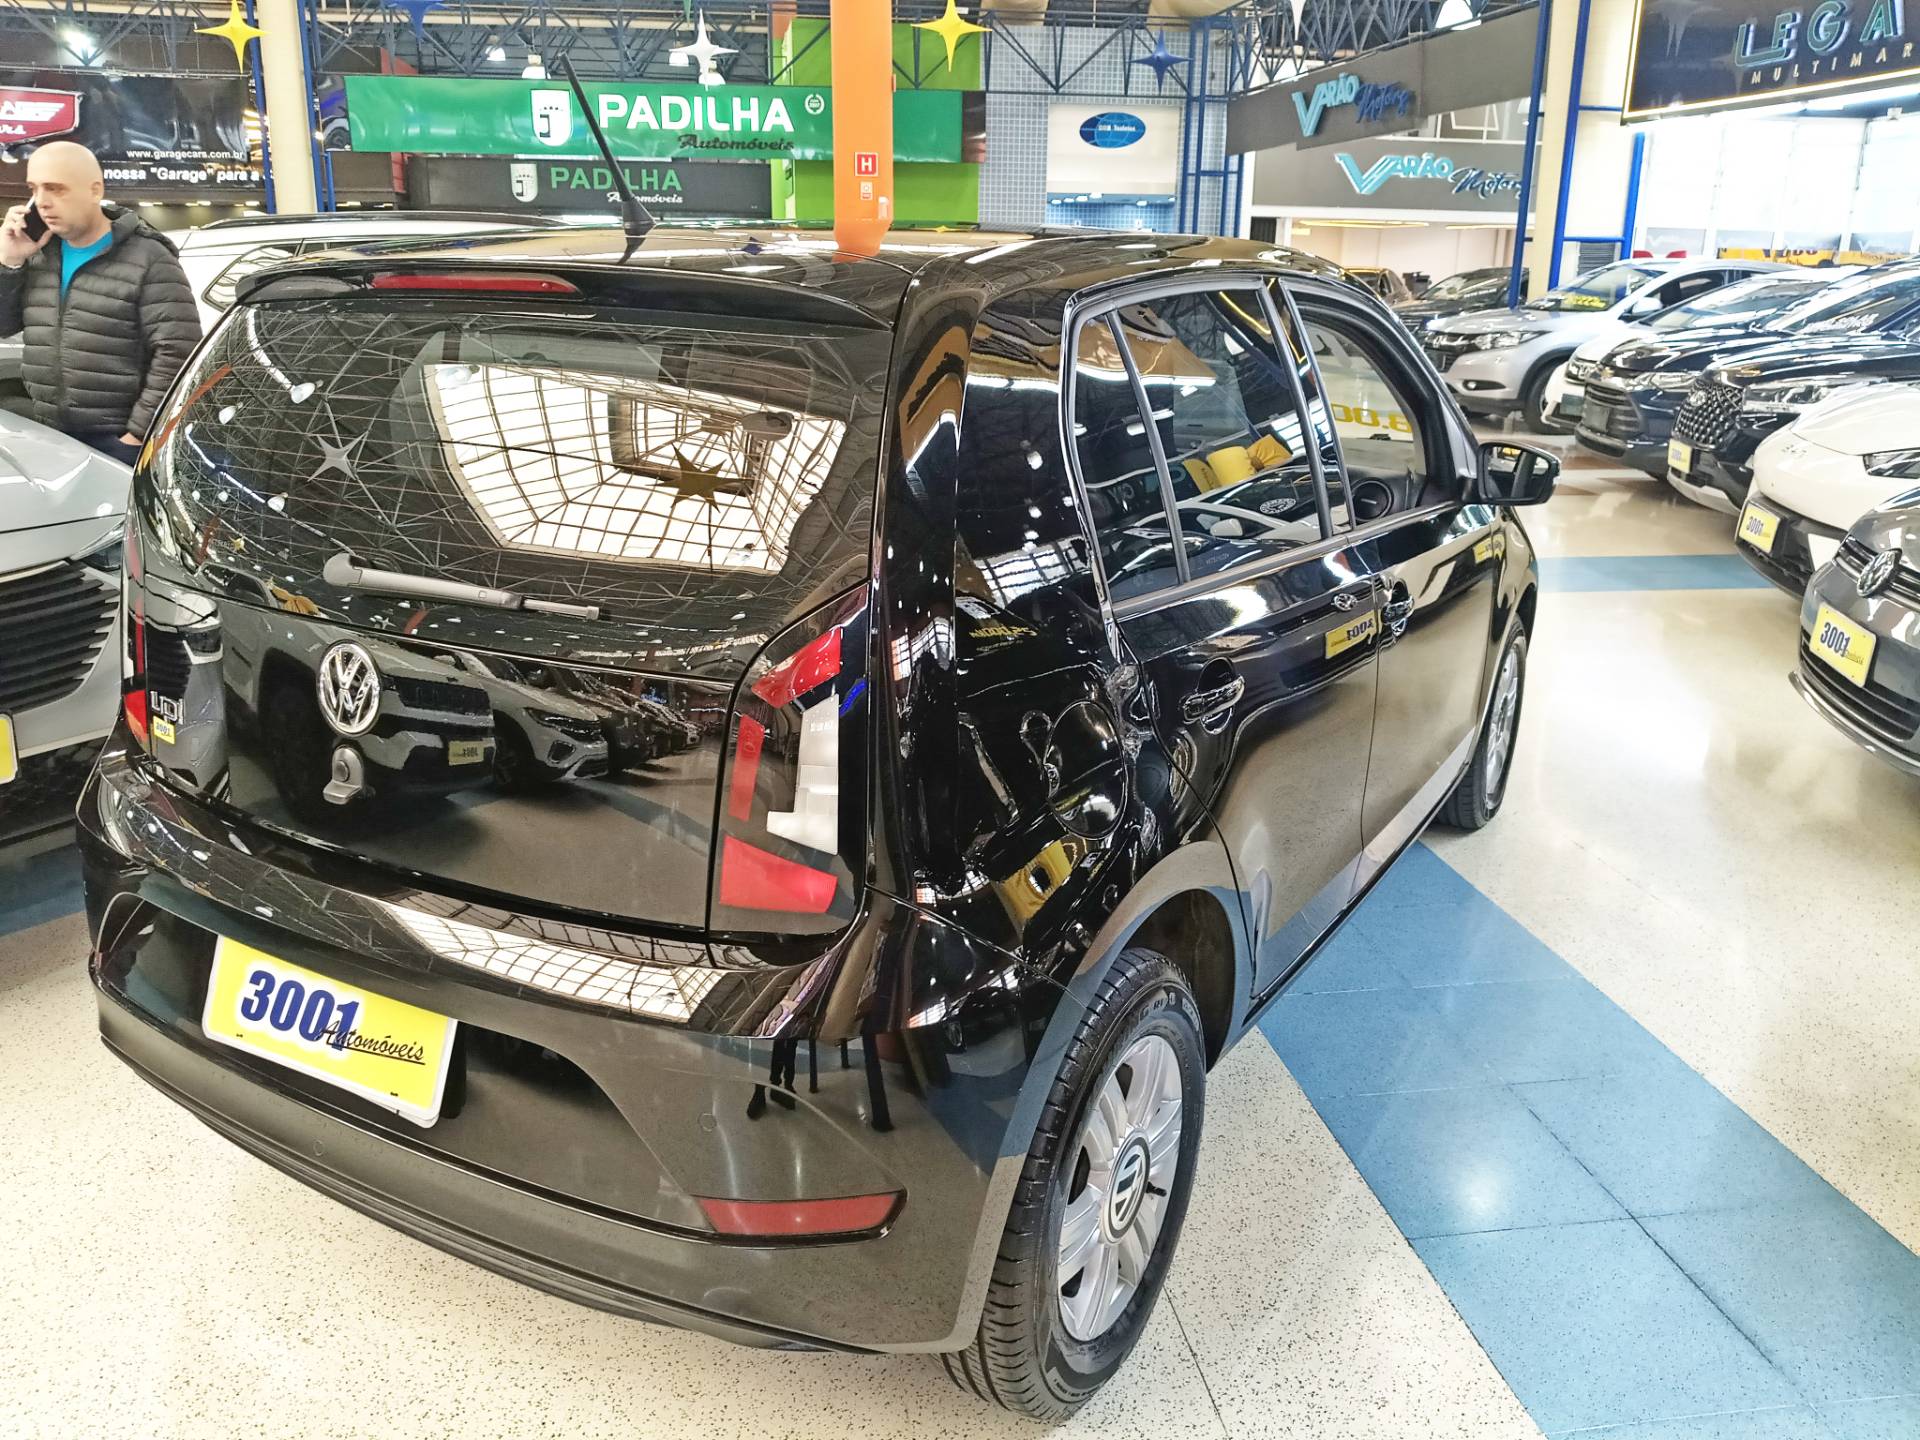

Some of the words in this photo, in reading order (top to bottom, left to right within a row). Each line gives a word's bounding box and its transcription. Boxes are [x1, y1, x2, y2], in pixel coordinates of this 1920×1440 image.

[1751, 42, 1914, 84] MULTIMAR
[598, 93, 795, 132] PADILHA
[1291, 72, 1360, 138] VARÃO
[126, 150, 244, 160] www.garagecars.com.br
[677, 133, 795, 151] Automóveis
[103, 168, 147, 180] nossa
[150, 167, 215, 183] "Garage"
[216, 169, 248, 183] para
[250, 173, 260, 181] a
[550, 167, 682, 191] PADLHA
[861, 157, 873, 172] H
[1334, 152, 1455, 195] VARÃO
[1820, 621, 1851, 658] 3001
[240, 969, 360, 1051] 3001
[315, 1020, 426, 1066] Automóveis
